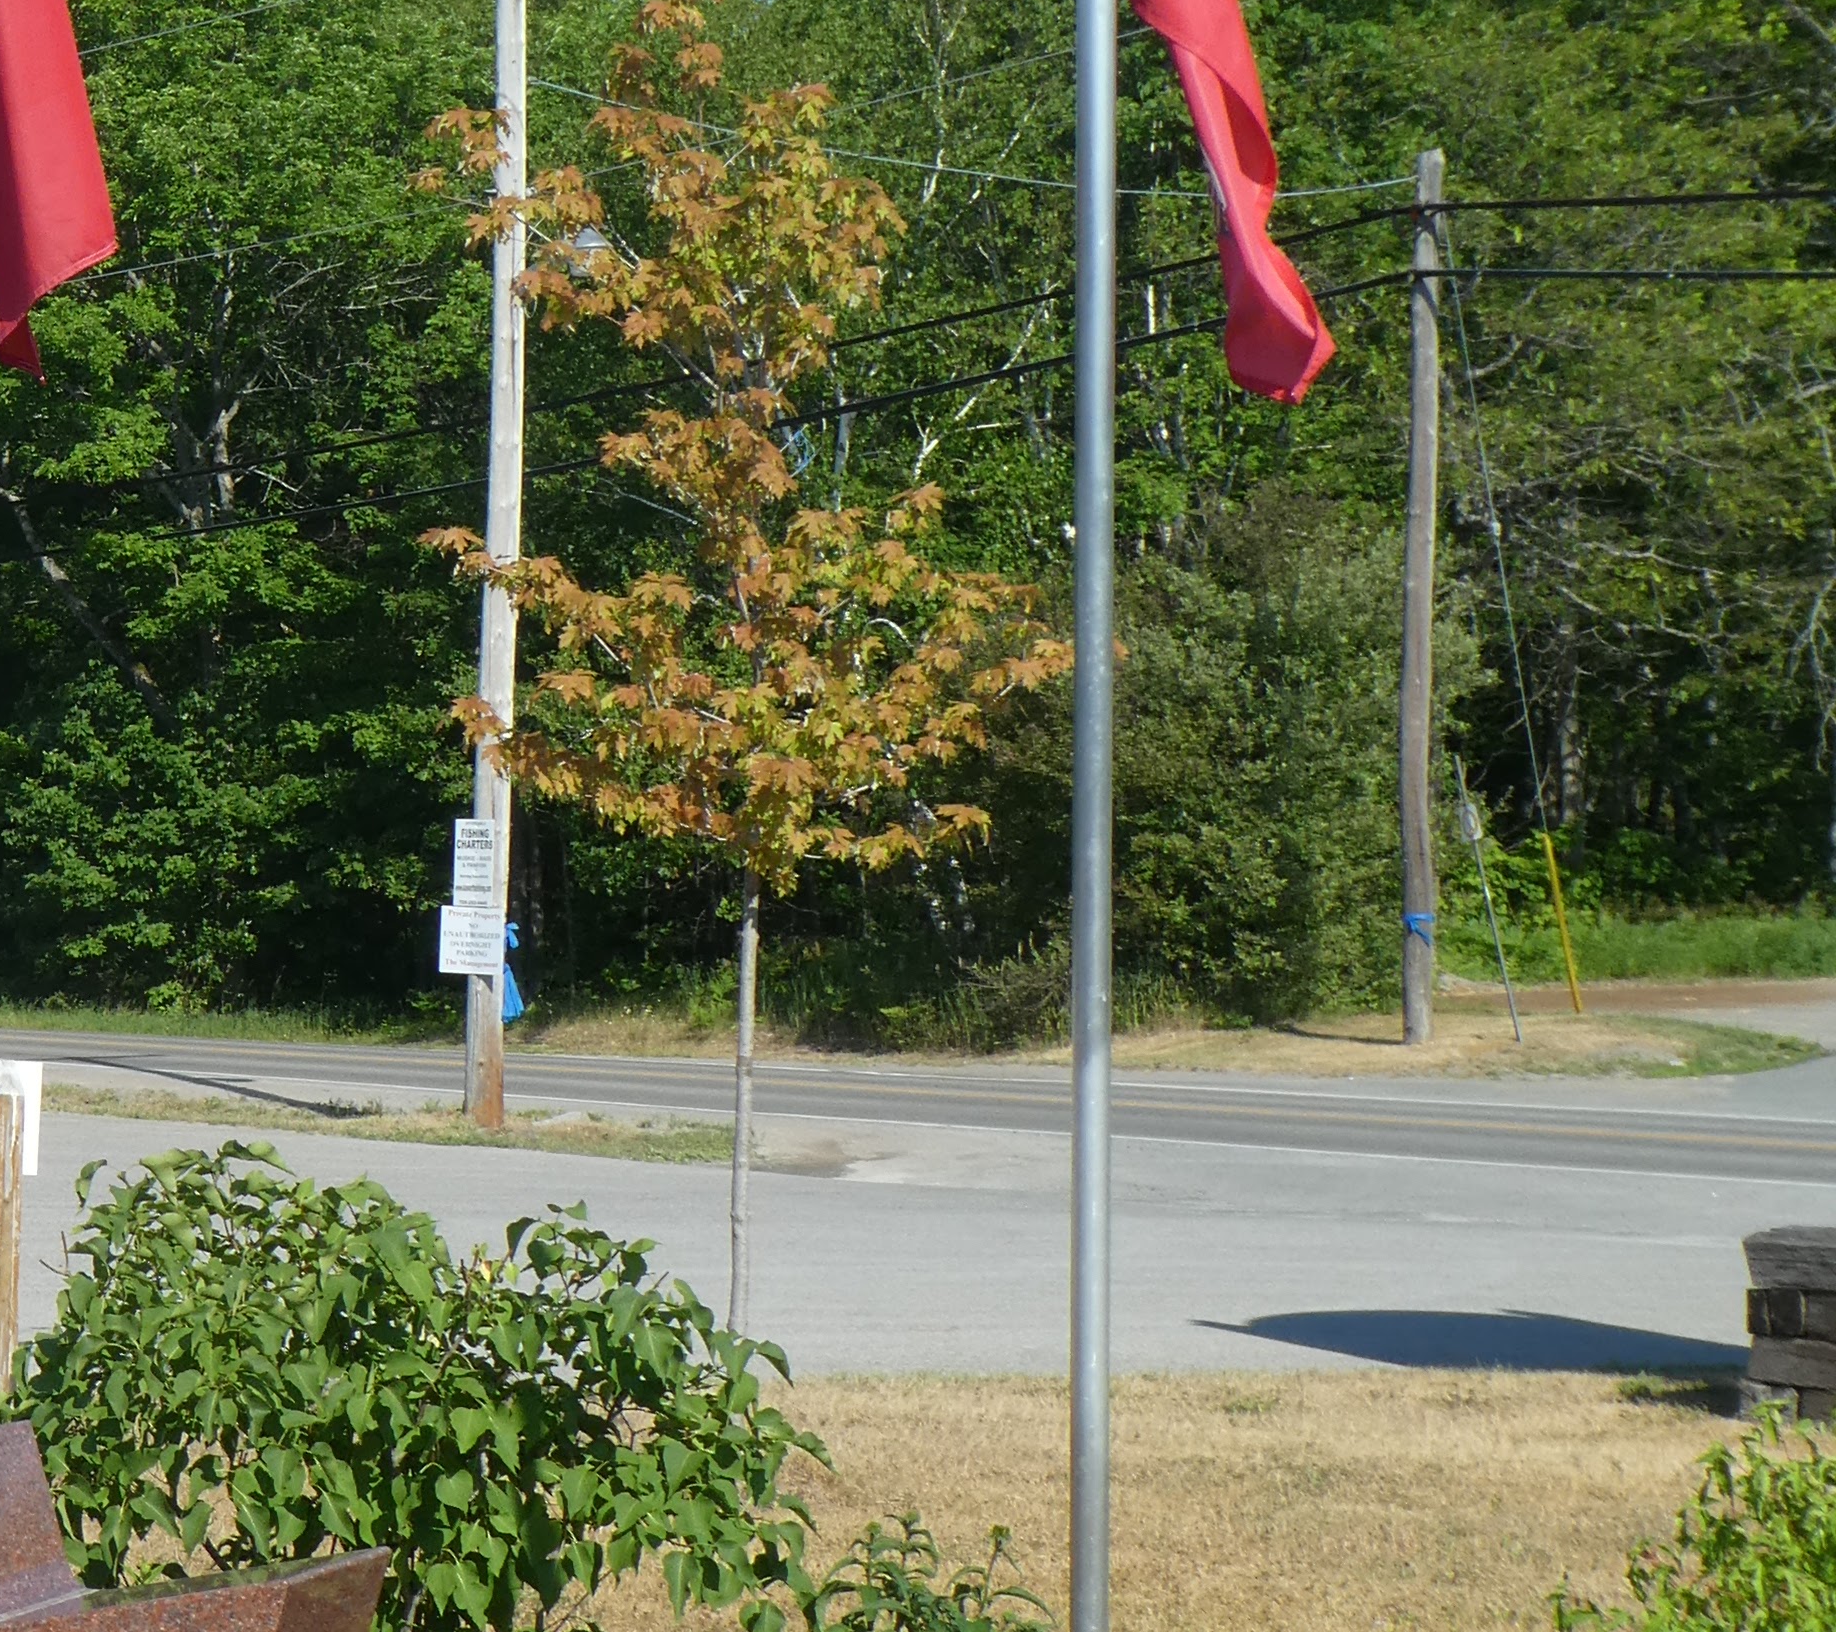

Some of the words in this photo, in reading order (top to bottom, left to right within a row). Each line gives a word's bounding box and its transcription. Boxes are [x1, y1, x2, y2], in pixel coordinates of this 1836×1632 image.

[461, 828, 490, 839] FISHING
[457, 839, 493, 850] CHARTERS
[456, 949, 488, 957] PARKING
